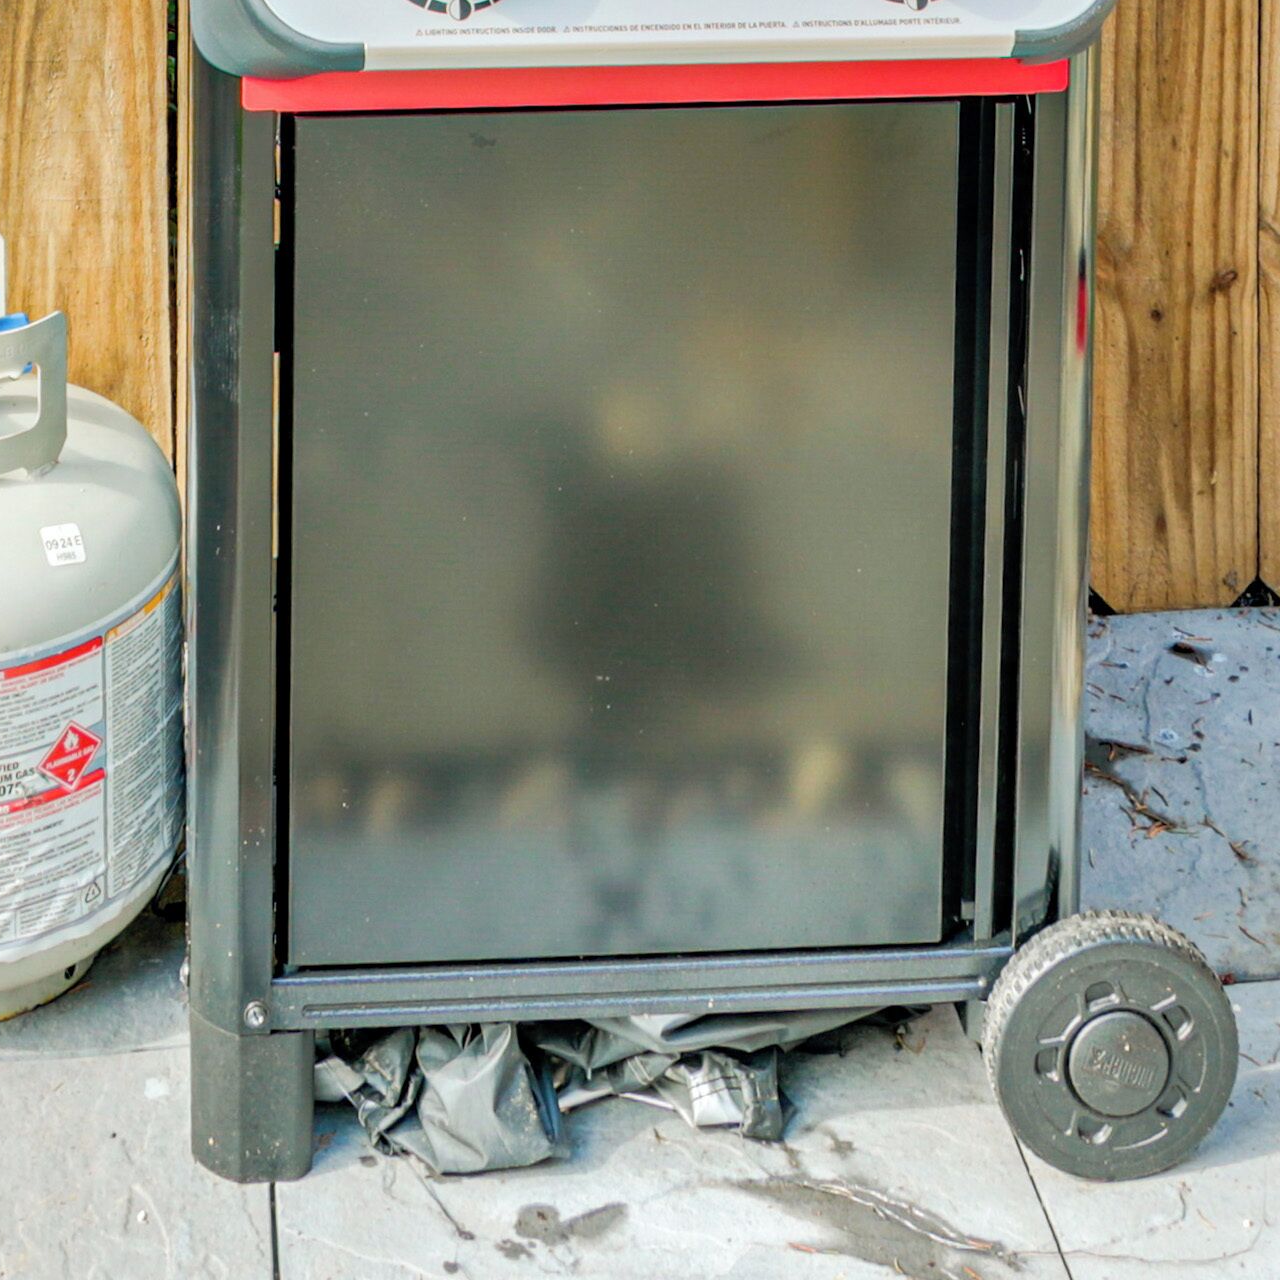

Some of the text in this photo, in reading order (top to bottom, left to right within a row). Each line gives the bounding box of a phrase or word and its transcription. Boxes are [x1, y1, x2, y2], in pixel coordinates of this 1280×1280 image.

[425, 28, 458, 36] LIGHTING
[459, 27, 510, 35] INSTRUCTIONS
[512, 26, 535, 34] INSIDE
[572, 24, 628, 32] INSTRUCCIONES
[641, 23, 680, 31] ENCENDIDO
[704, 22, 736, 30] INTERIOR
[748, 21, 757, 29] LA
[802, 19, 853, 27] INSTRUCTIONS
[854, 18, 897, 26] D'ALLUMAGE
[899, 17, 921, 25] PORTE
[15, 767, 35, 780] GAS
[66, 768, 76, 782] 2
